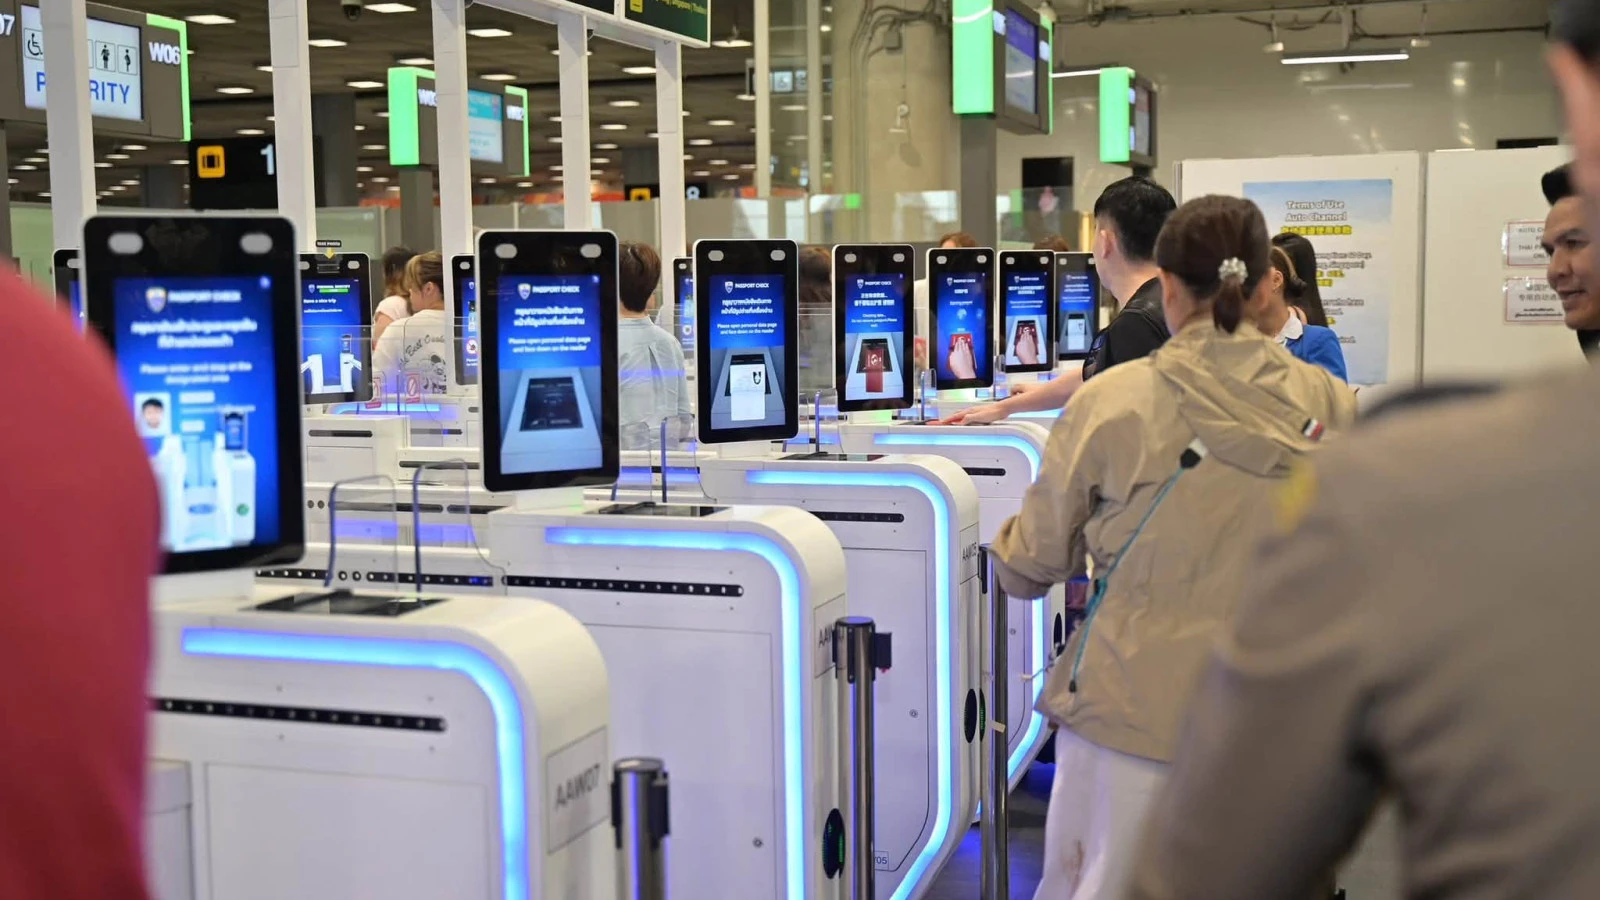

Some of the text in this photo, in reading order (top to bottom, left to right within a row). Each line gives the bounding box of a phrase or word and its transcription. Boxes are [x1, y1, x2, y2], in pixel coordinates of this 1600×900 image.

[149, 42, 181, 65] W06
[36, 72, 130, 104] PRITY
[1287, 200, 1344, 209] Terms of Use
[1286, 211, 1347, 221] Auto Channel
[555, 763, 600, 812] AAW07
[874, 856, 888, 865] 05
